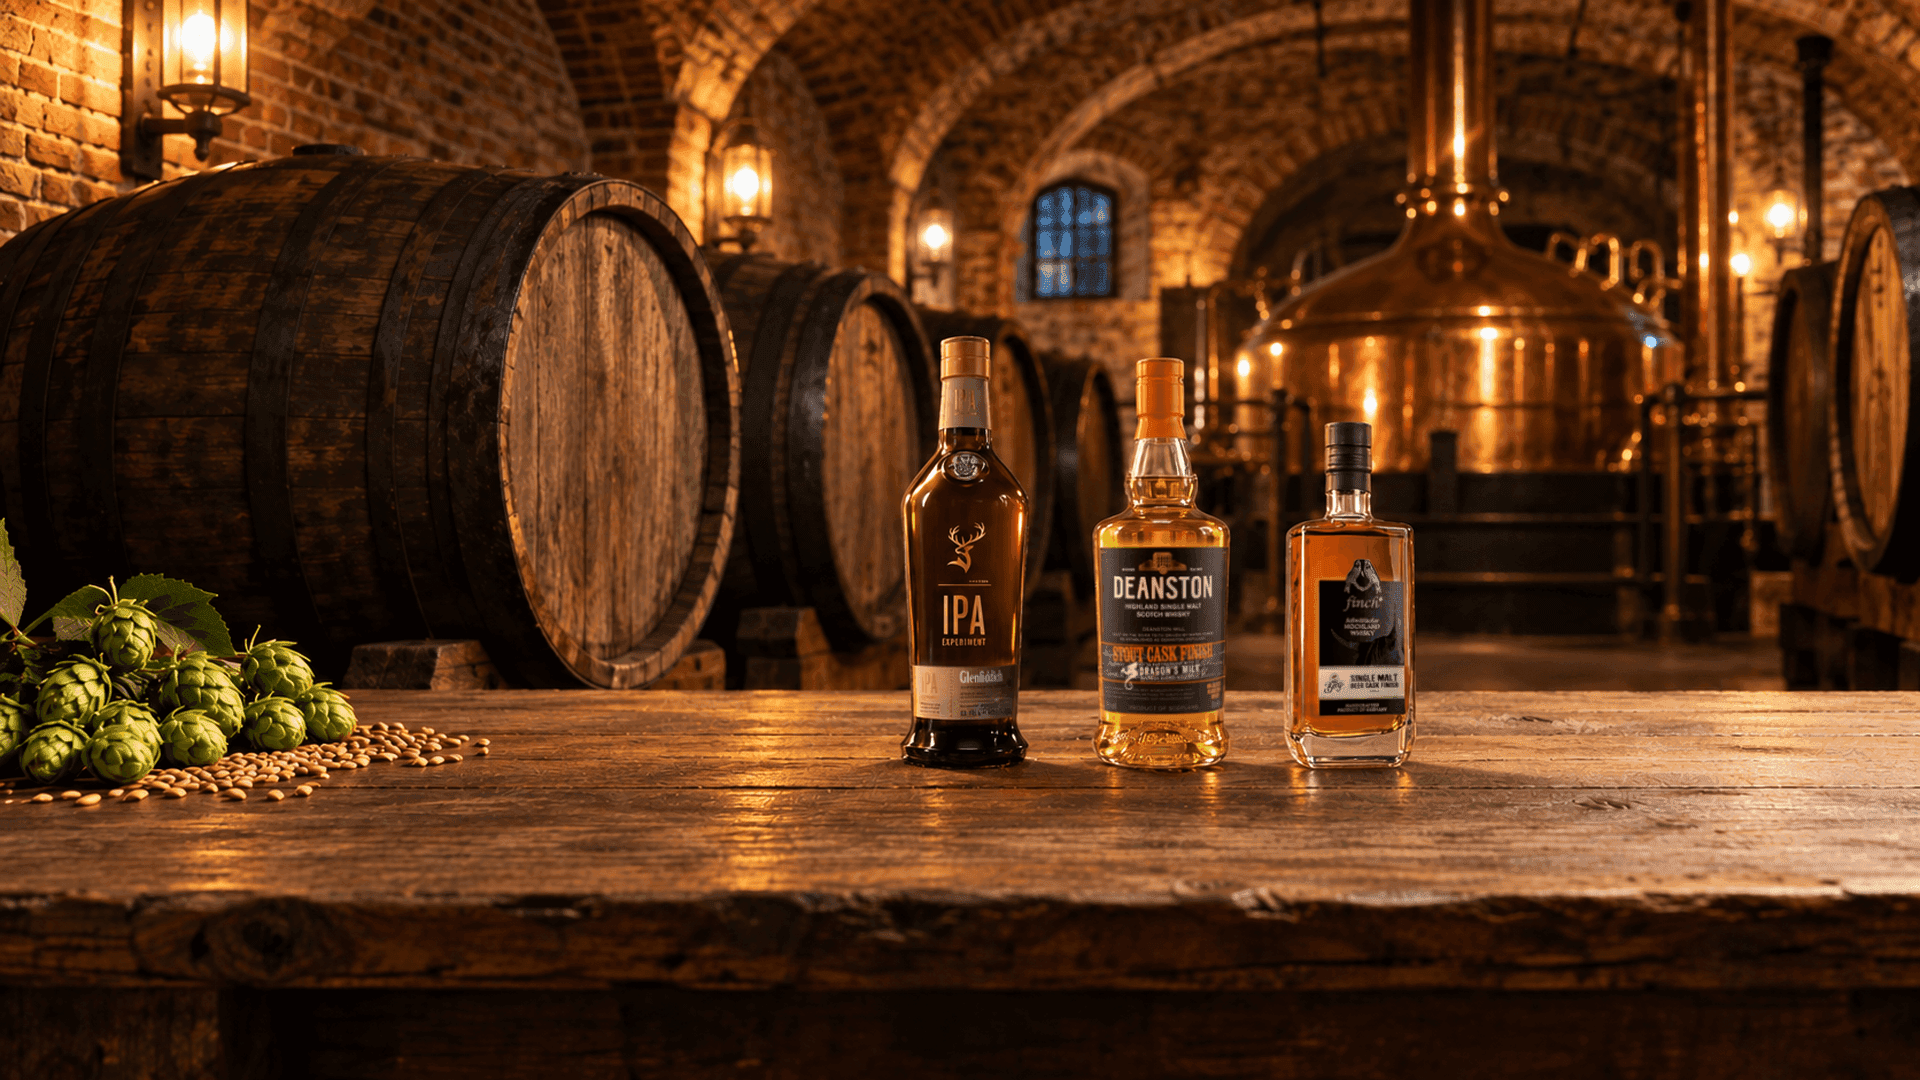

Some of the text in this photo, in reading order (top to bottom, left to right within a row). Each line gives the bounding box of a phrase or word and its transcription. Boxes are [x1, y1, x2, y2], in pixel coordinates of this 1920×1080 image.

[954, 389, 977, 411] IPA
[1113, 575, 1213, 600] DEANSTON
[943, 595, 986, 636] IPA
[1160, 603, 1185, 611] SINGLE
[1187, 602, 1202, 610] MALT
[942, 638, 986, 647] EXPERIMENT
[1112, 643, 1213, 663] STOUT CASK FINISH
[1350, 673, 1397, 682] SINGLE MALT
